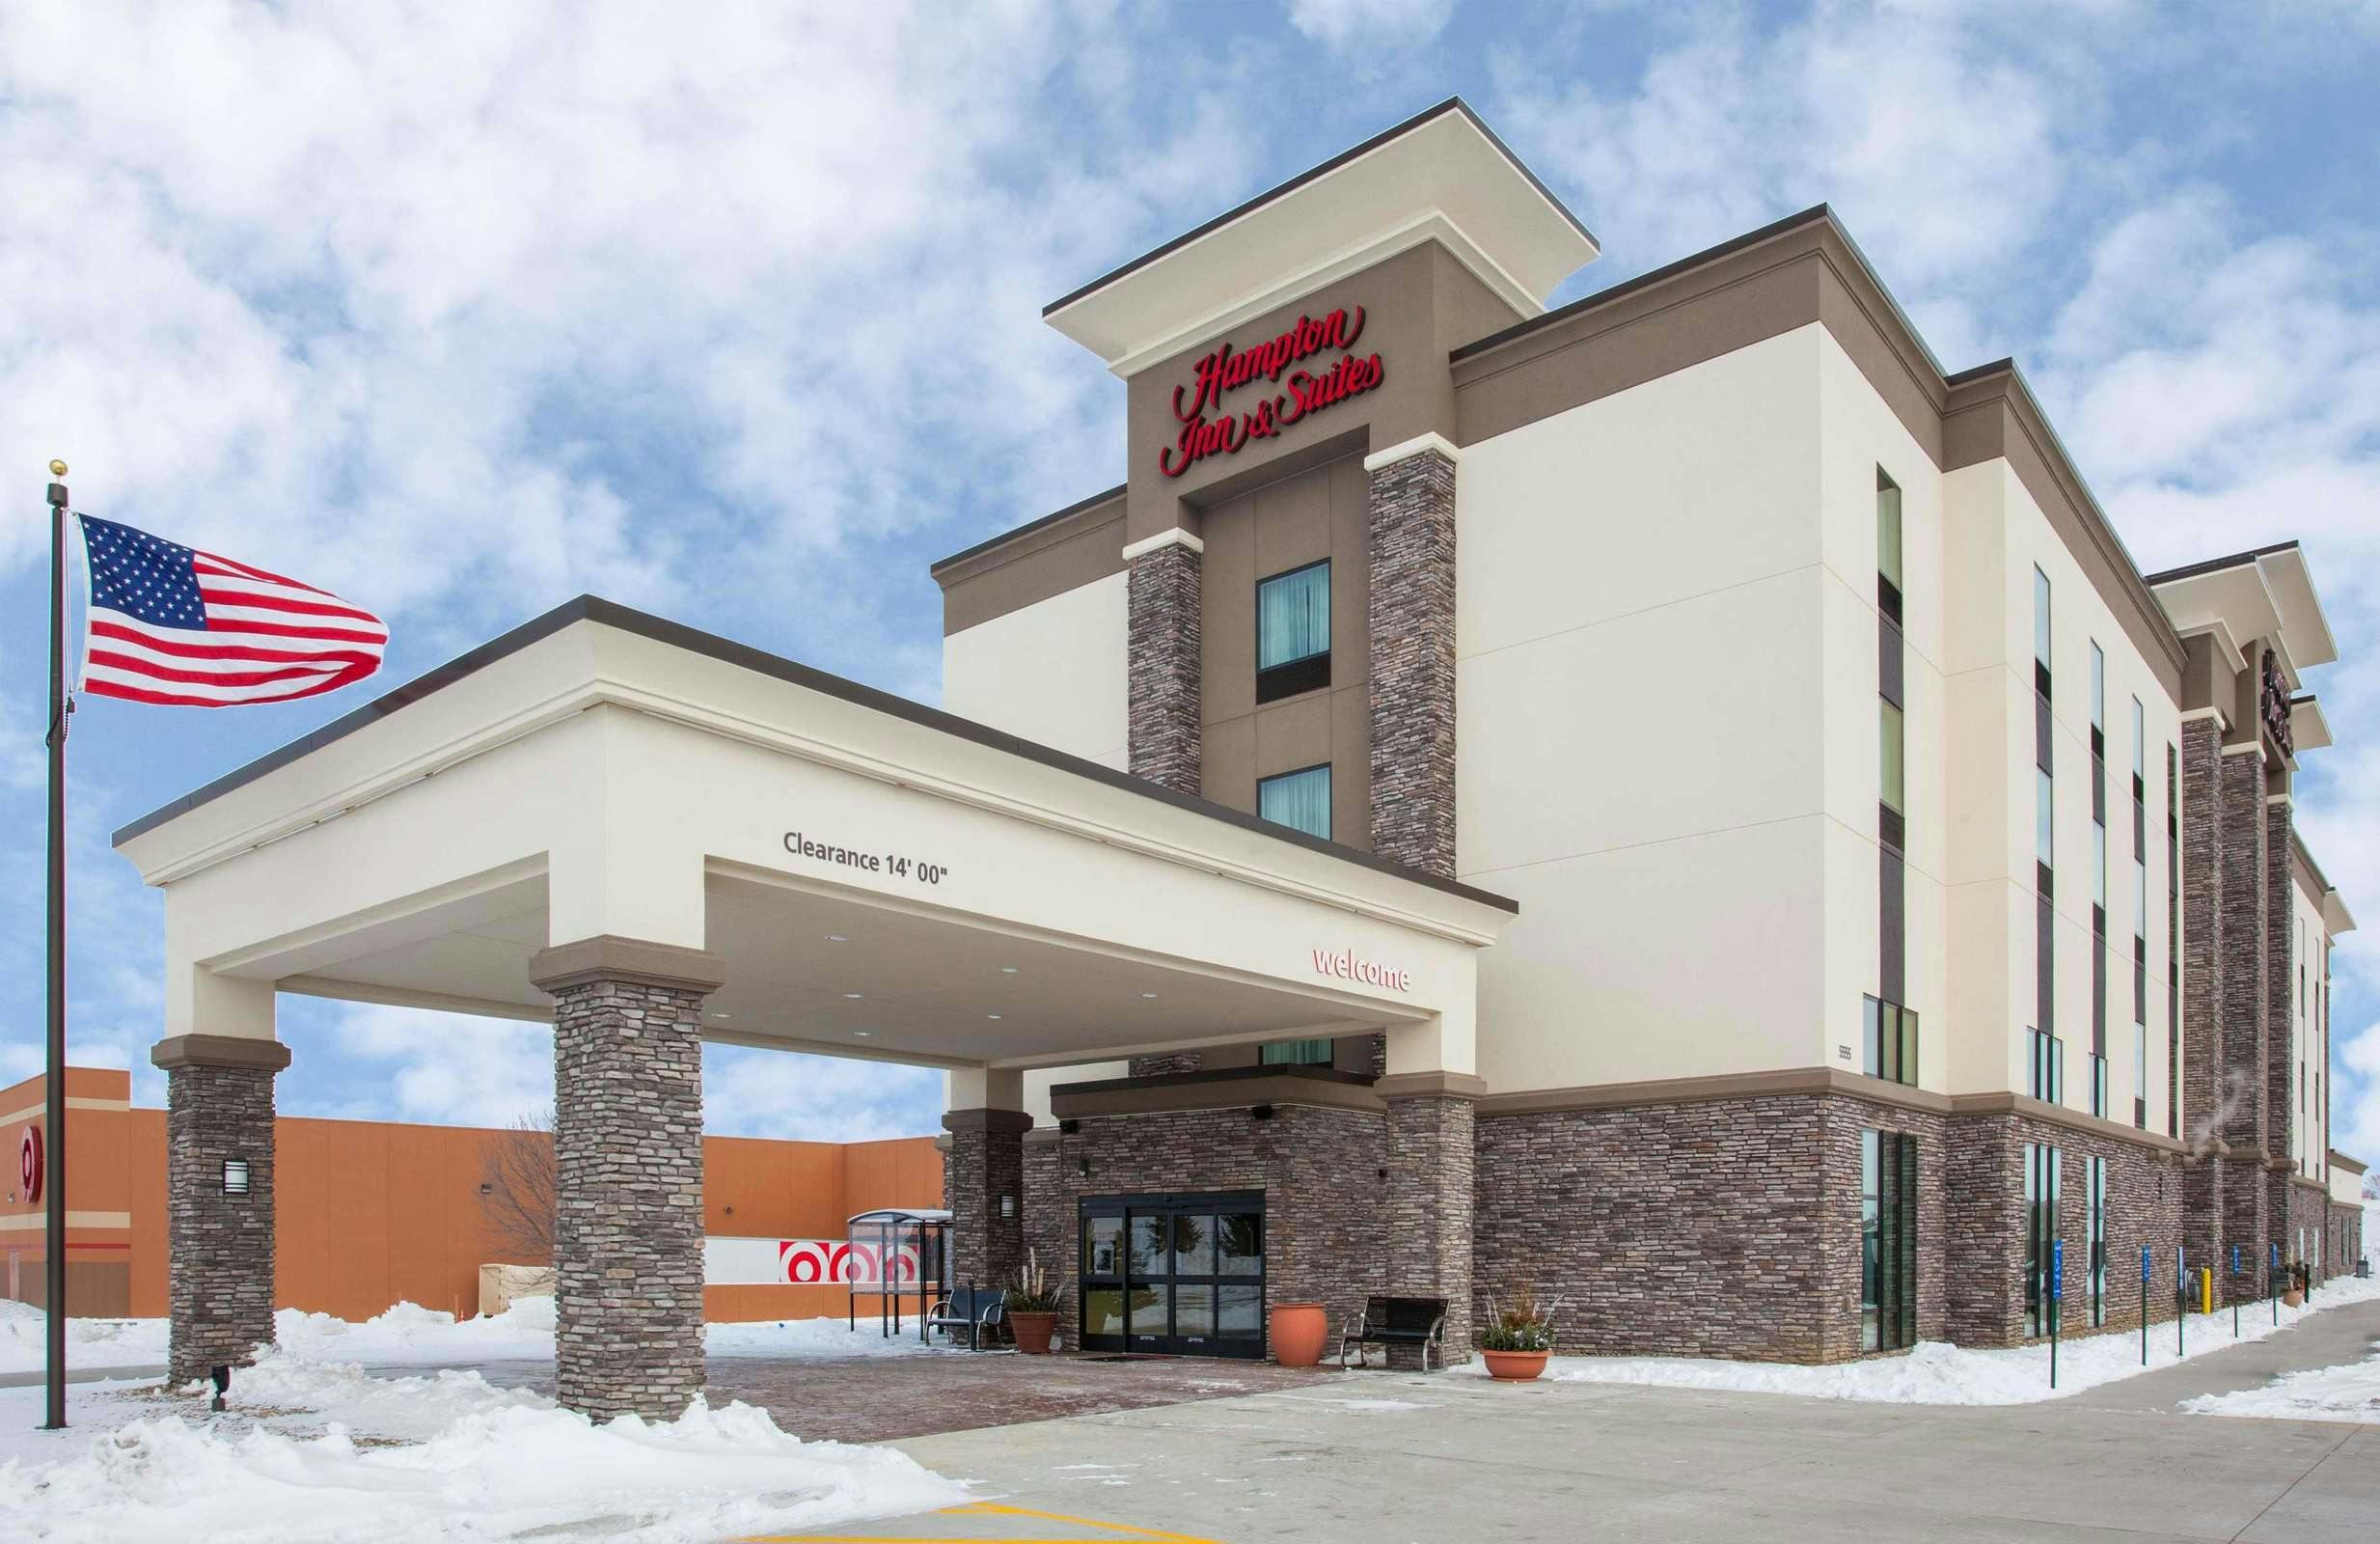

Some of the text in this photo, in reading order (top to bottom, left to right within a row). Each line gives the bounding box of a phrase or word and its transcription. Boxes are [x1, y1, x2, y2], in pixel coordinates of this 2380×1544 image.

[1172, 303, 1367, 424] Hampton
[1159, 352, 1385, 479] Inn & Suites
[782, 831, 948, 885] Clearance 14' 00"
[1313, 949, 1411, 993] welcome
